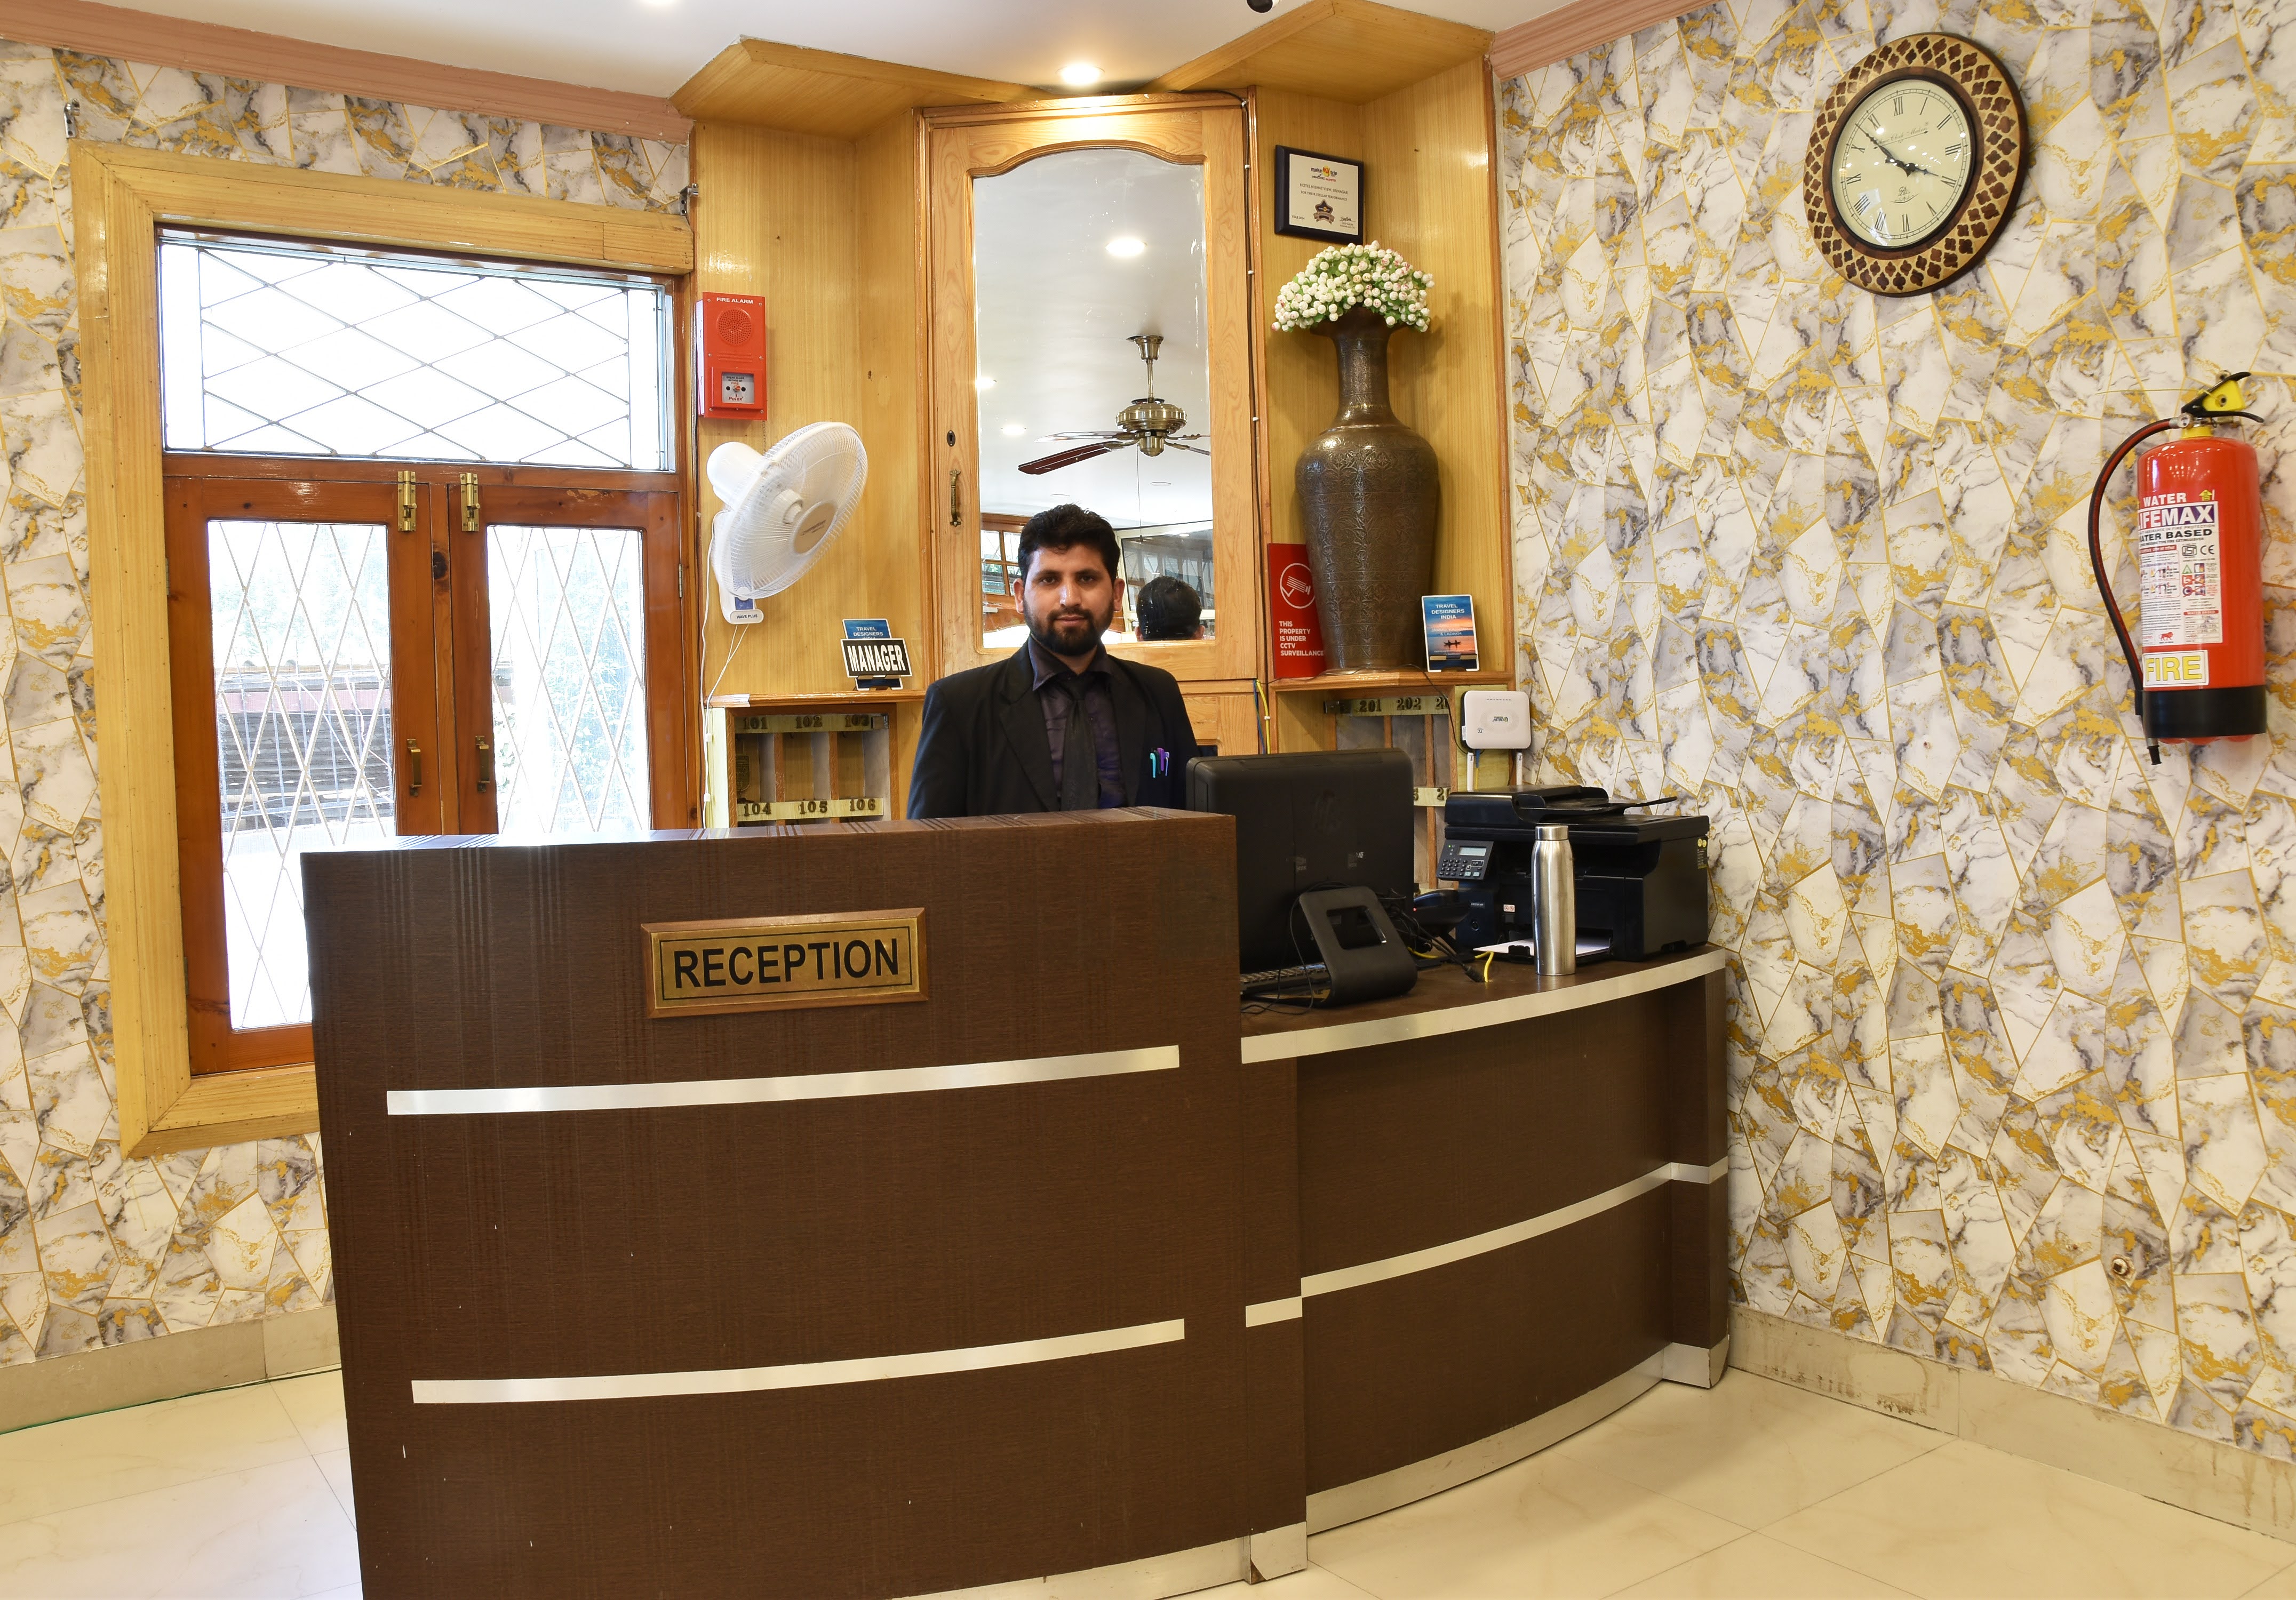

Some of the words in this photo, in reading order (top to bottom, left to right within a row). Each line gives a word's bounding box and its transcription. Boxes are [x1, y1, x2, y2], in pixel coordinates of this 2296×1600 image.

[1893, 96, 1903, 116] XII
[2143, 492, 2187, 507] WATER
[2139, 533, 2162, 542] ATER
[2166, 529, 2212, 539] BASED
[847, 645, 906, 671] MANAGER
[2146, 655, 2202, 682] FIRE
[1359, 699, 1382, 713] 201
[1396, 697, 1421, 711] 202
[743, 716, 768, 730] 101
[796, 715, 823, 729] 102
[845, 714, 870, 727] 103
[744, 802, 771, 817] 104
[799, 801, 828, 814] 105
[849, 798, 876, 812] 106
[673, 938, 899, 989] RECEPTION
